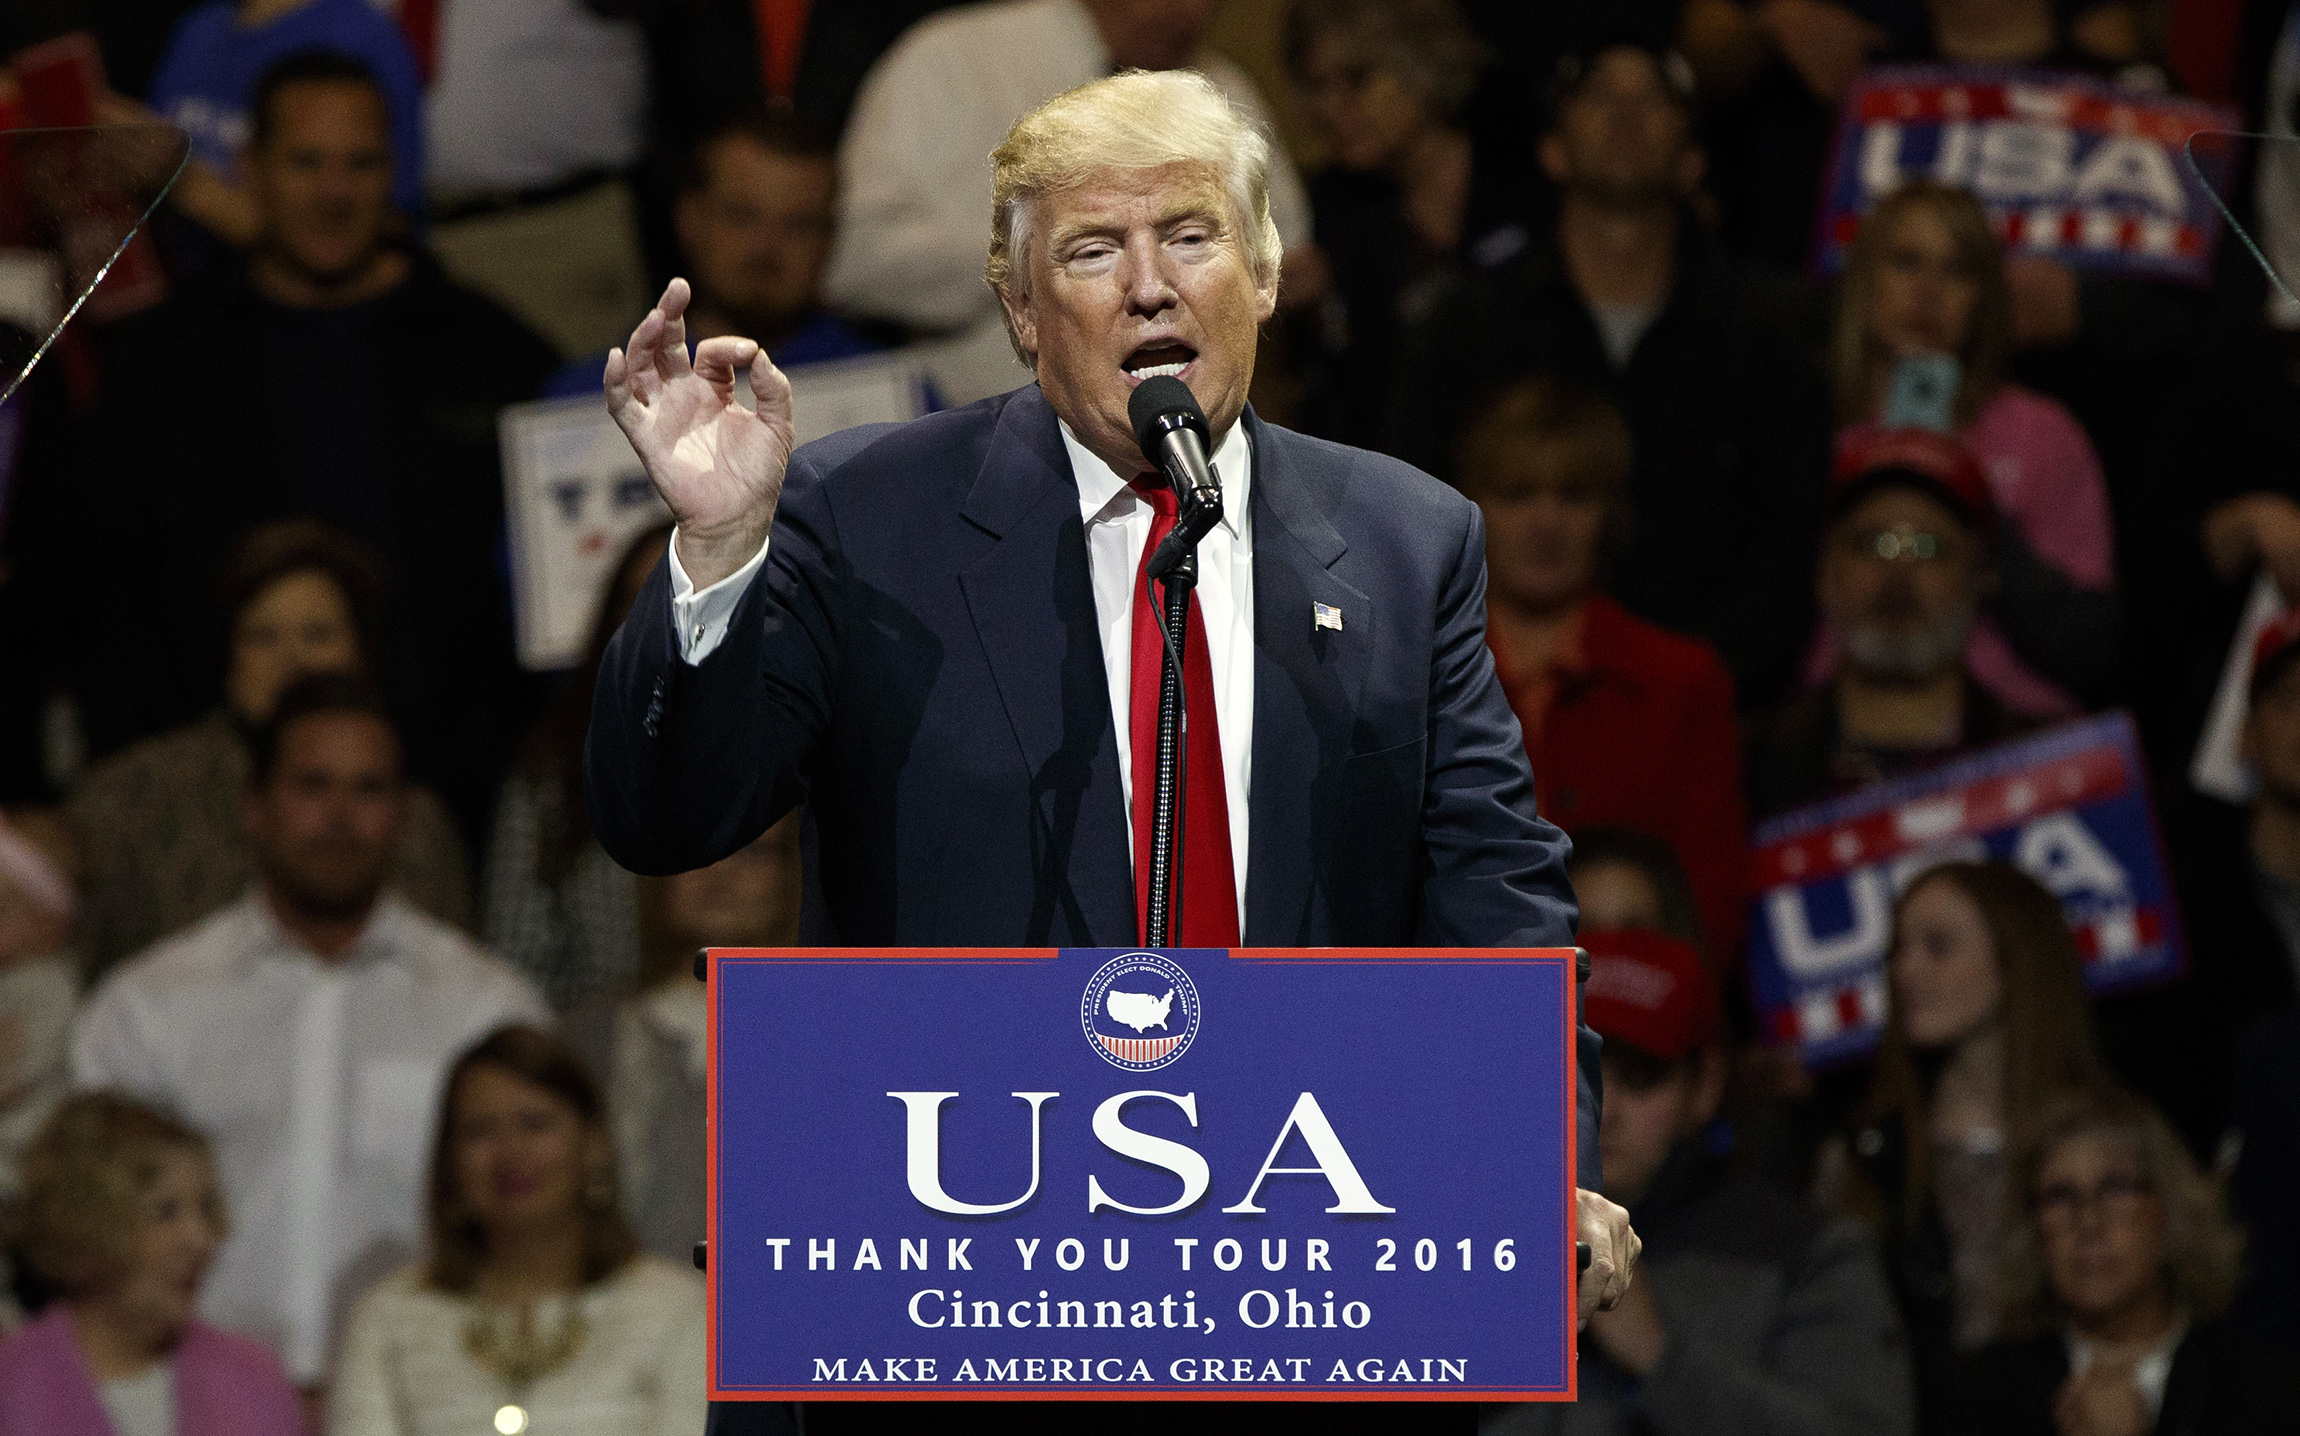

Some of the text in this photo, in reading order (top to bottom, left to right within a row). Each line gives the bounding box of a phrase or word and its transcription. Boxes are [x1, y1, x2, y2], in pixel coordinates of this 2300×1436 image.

[1859, 116, 2188, 214] USA
[1094, 975, 1116, 1015] PRESIDENT
[1116, 966, 1138, 976] ELECT
[1139, 966, 1170, 979] DONALD
[1175, 984, 1188, 1015] TRUMP
[886, 1090, 1397, 1216] USA
[765, 1237, 1517, 1272] THANK YOU TOUR 2016
[908, 1287, 1372, 1335] Cincinnati, Ohio
[811, 1357, 1469, 1383] MAKE AMERICA GREAT AGAIN
